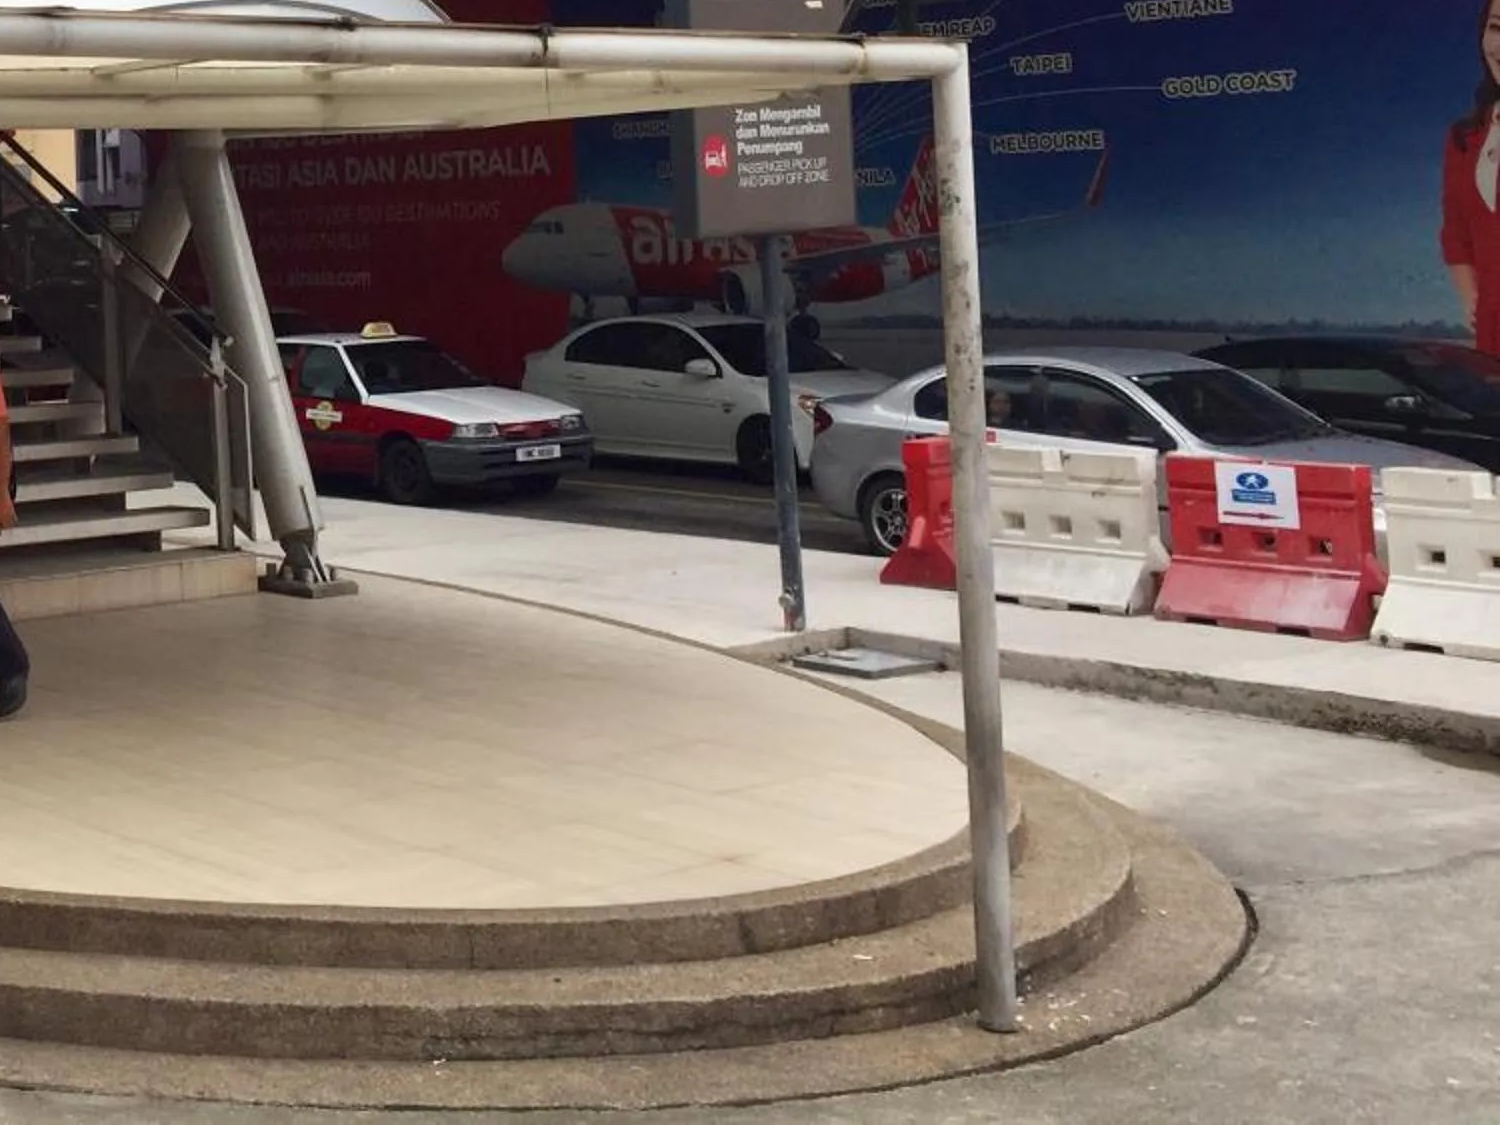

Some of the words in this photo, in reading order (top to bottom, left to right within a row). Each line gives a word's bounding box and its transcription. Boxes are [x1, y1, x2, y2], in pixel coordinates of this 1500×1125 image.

[1010, 53, 1072, 74] TAIPEI
[1163, 75, 1220, 97] GOLD
[1224, 71, 1296, 94] COAST
[990, 130, 1104, 153] MELBOURNE
[287, 158, 339, 187] ASIA
[346, 155, 396, 185] DAN
[403, 144, 552, 182] AUSTRALIA
